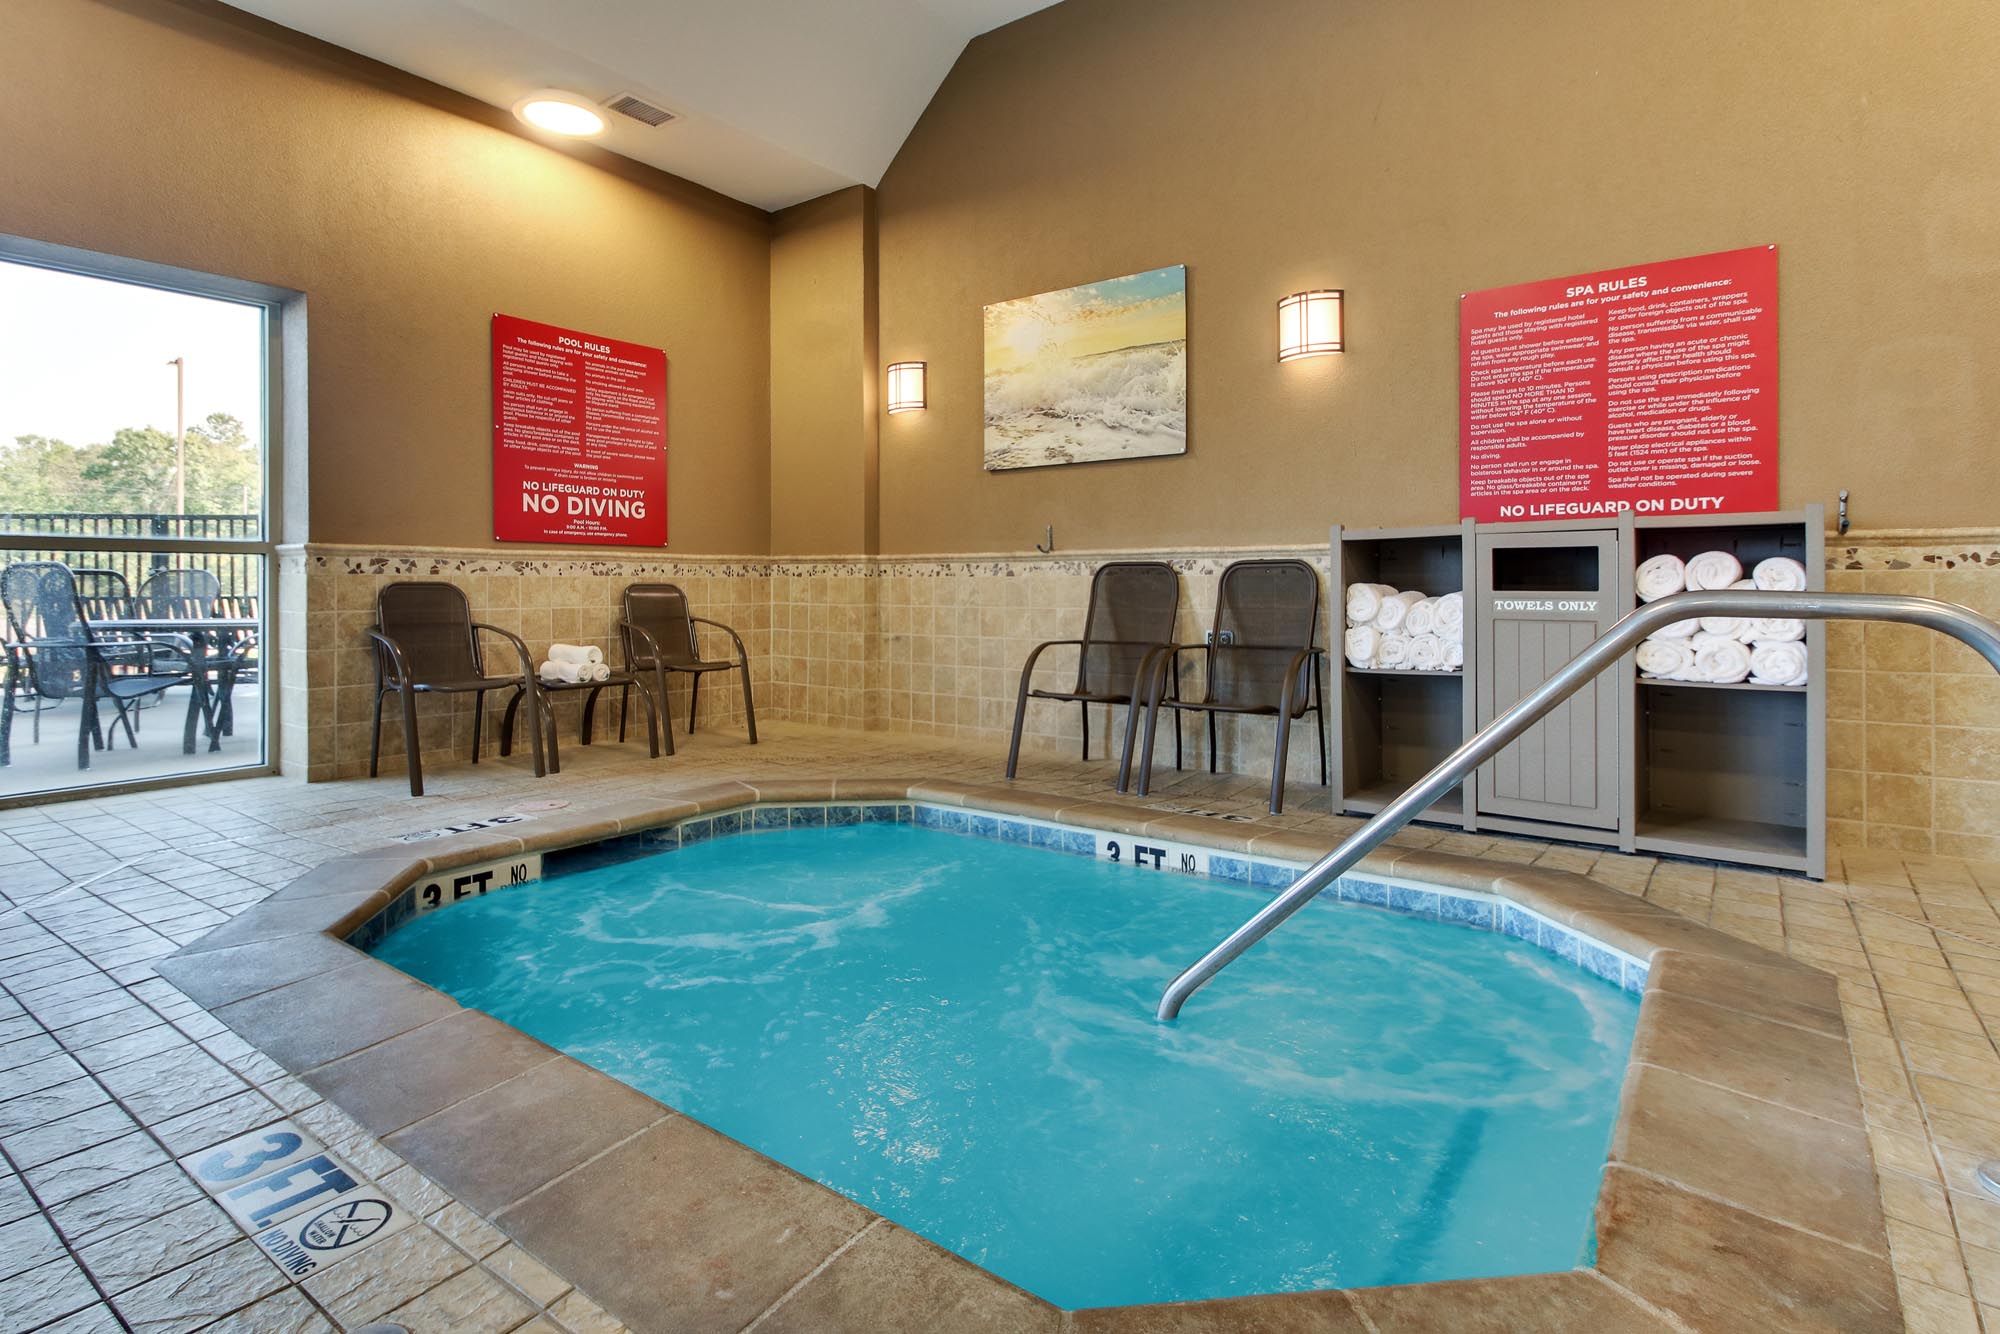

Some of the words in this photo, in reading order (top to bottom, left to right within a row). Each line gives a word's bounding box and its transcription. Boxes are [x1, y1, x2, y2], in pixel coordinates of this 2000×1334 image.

[1566, 284, 1595, 298] SPA
[1598, 276, 1647, 293] RULES
[1510, 305, 1548, 315] following
[1600, 295, 1620, 304] your
[1622, 291, 1649, 300] safety
[1650, 287, 1668, 296] and
[1670, 280, 1732, 293] convenience:
[1647, 302, 1668, 310] drink,
[1669, 297, 1711, 307] containers,
[1712, 292, 1748, 301] wrappers
[1533, 316, 1567, 326] registered
[558, 337, 582, 348] POOL
[584, 342, 610, 354] RULES
[1480, 347, 1501, 356] guests
[1565, 336, 1594, 344] entering
[1487, 337, 1508, 345] guests
[528, 340, 552, 351] following
[618, 359, 646, 368] convenience:
[1503, 364, 1543, 372] temperature
[1608, 365, 1634, 373] consult
[1641, 361, 1675, 371] physician
[1658, 369, 1702, 380] prescription
[1704, 364, 1751, 374] medications
[1636, 408, 1677, 416] medication
[1663, 417, 1700, 426] pregnant,
[1470, 428, 1507, 436] supervision.
[1531, 432, 1575, 441] accompanied
[1470, 443, 1505, 451] responsible
[1650, 440, 1684, 448] electrical
[1685, 438, 1726, 447] appliances
[523, 481, 540, 490] NO
[542, 482, 600, 495] LIFEGUARD
[602, 487, 617, 496] ON
[619, 489, 644, 498] DUTY
[523, 493, 560, 514] NO
[567, 497, 646, 520] DIVING
[1500, 505, 1525, 516] NO
[1529, 501, 1631, 515] LIFEGUARD
[1636, 499, 1665, 512] ON
[1670, 497, 1725, 510] DUTY
[1495, 601, 1553, 610] TOWELS
[1558, 601, 1597, 611] ONLY
[1107, 841, 1120, 861] 3
[1134, 845, 1166, 870] FT
[1181, 853, 1195, 872] NO
[423, 884, 441, 904] 3
[454, 871, 493, 900] FT
[511, 864, 527, 885] NO
[198, 1132, 302, 1182] 3
[260, 1228, 289, 1247] NO
[308, 1230, 327, 1244] WATER
[271, 1240, 317, 1275] DIVING
